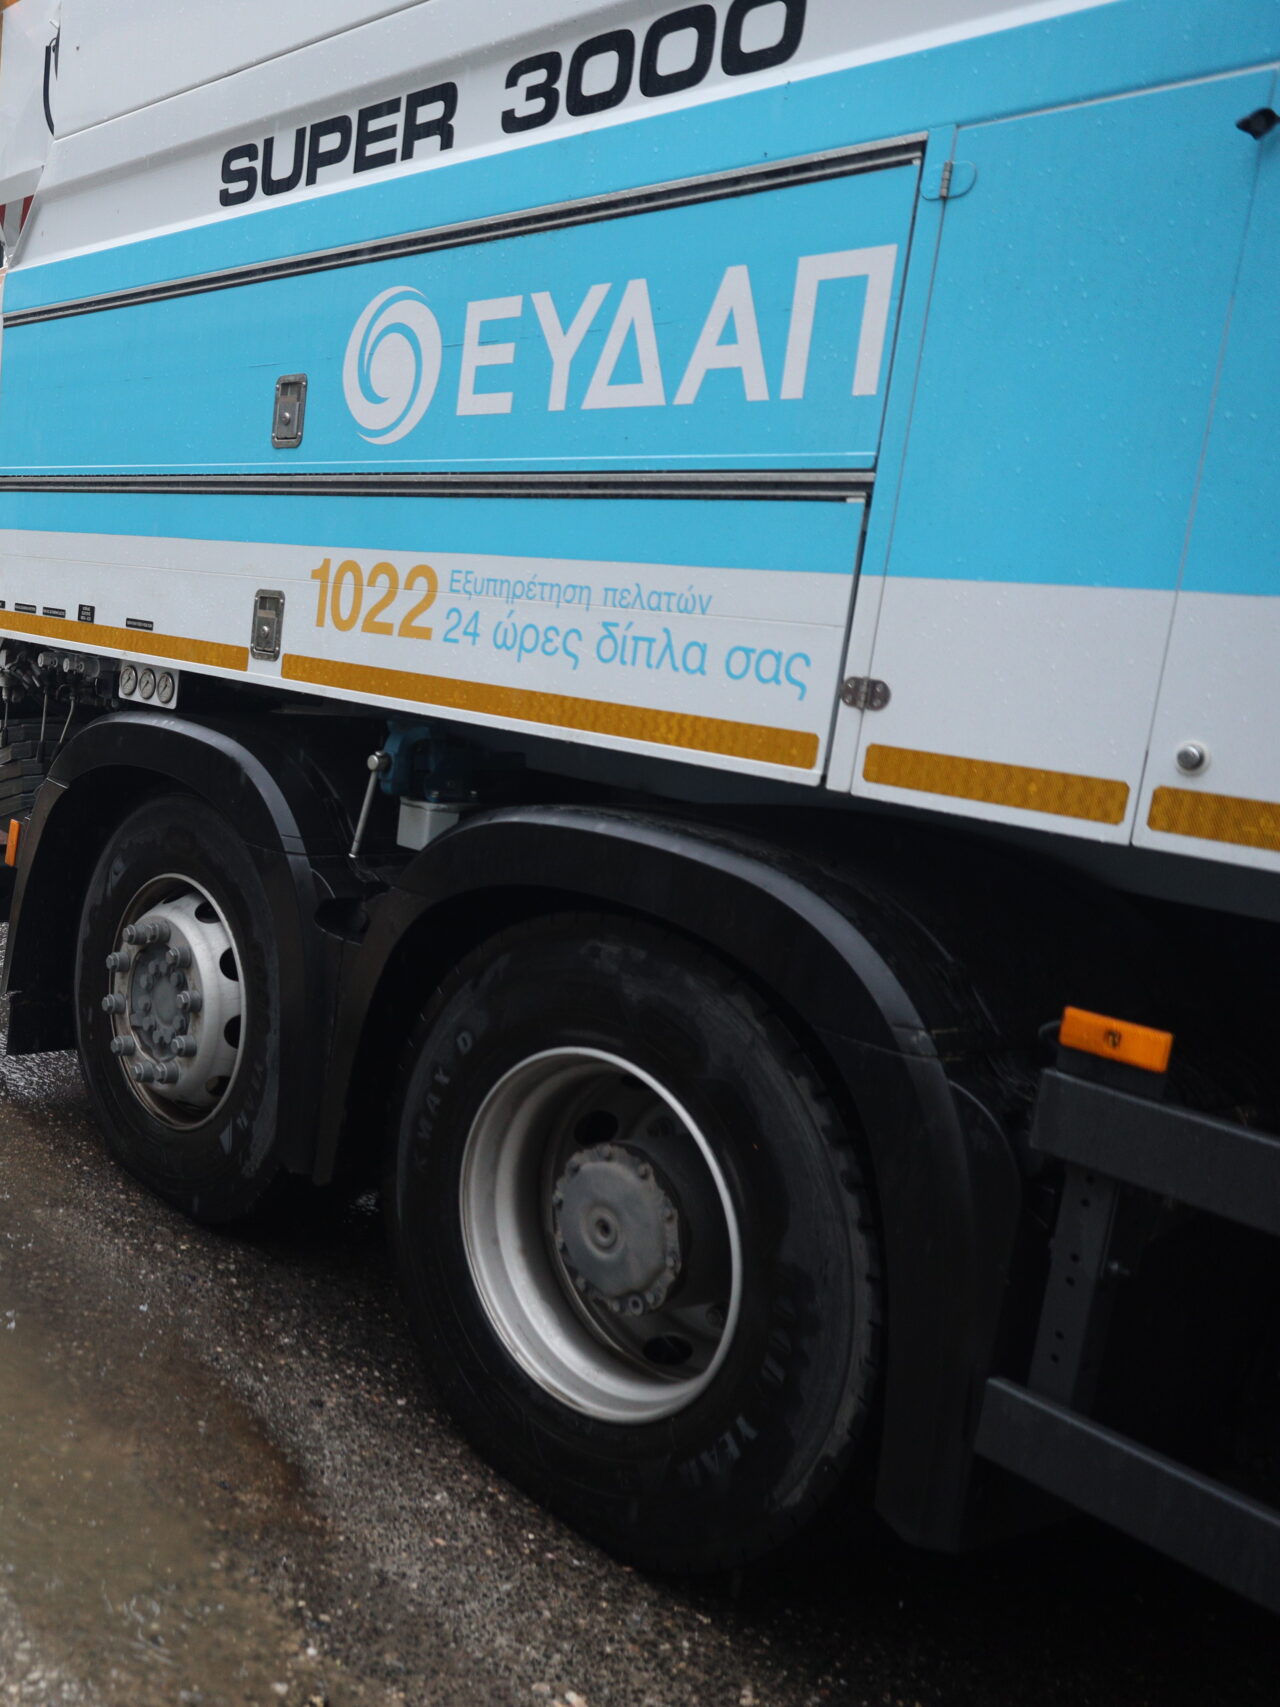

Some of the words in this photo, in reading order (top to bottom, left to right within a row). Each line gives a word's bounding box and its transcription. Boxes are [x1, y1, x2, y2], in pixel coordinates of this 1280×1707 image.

[219, 81, 459, 207] SUPER
[501, 0, 808, 134] 3000
[456, 244, 898, 416] ΕΥΔΑΠ
[310, 558, 439, 641] 1022
[449, 569, 592, 612] Εξυπηρέτηση
[604, 582, 713, 615] πελατών
[442, 607, 481, 646] 24
[493, 609, 583, 669] ώρες
[596, 620, 707, 676] δίπλα
[725, 644, 812, 701] σας
